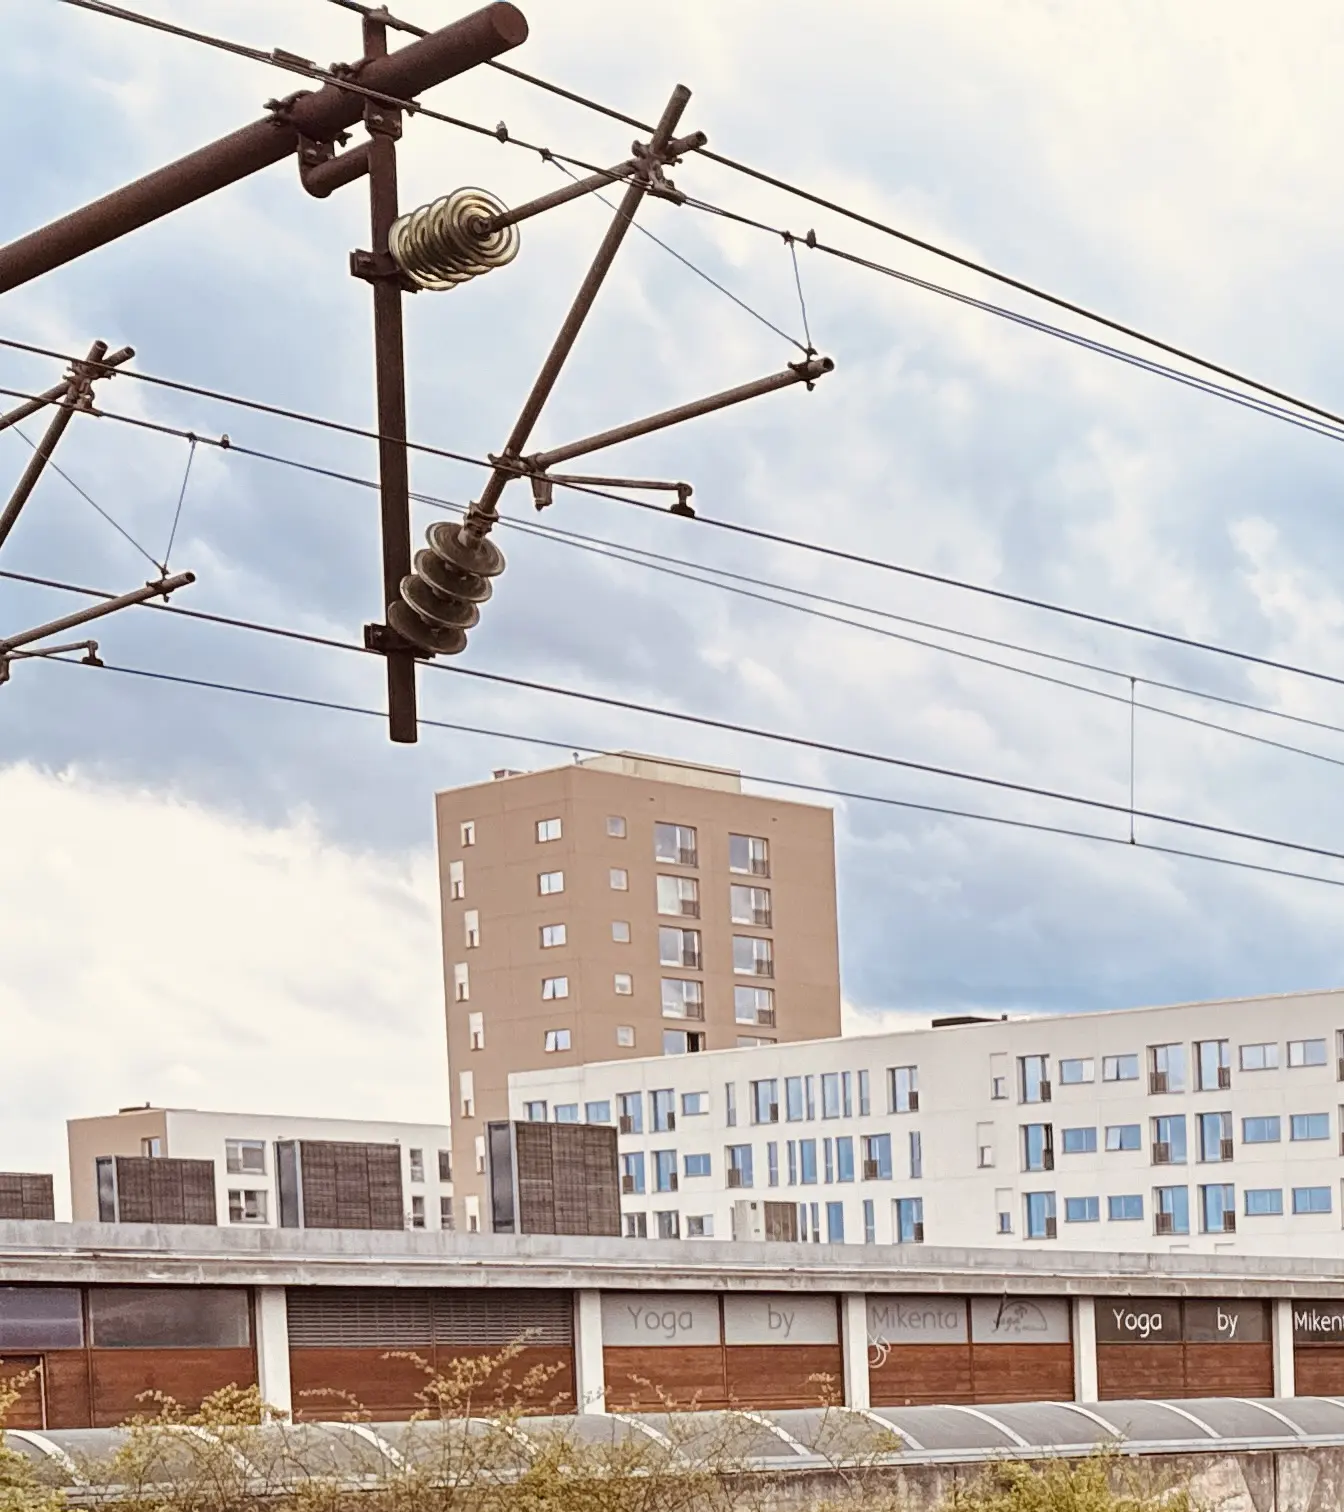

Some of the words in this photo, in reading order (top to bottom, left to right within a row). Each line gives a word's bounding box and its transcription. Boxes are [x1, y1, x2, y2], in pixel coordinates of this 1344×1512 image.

[626, 1305, 694, 1339] Yoga
[767, 1303, 795, 1338] by
[871, 1304, 959, 1330] Mikenta
[1112, 1308, 1163, 1338] Yoga
[1217, 1306, 1239, 1338] by
